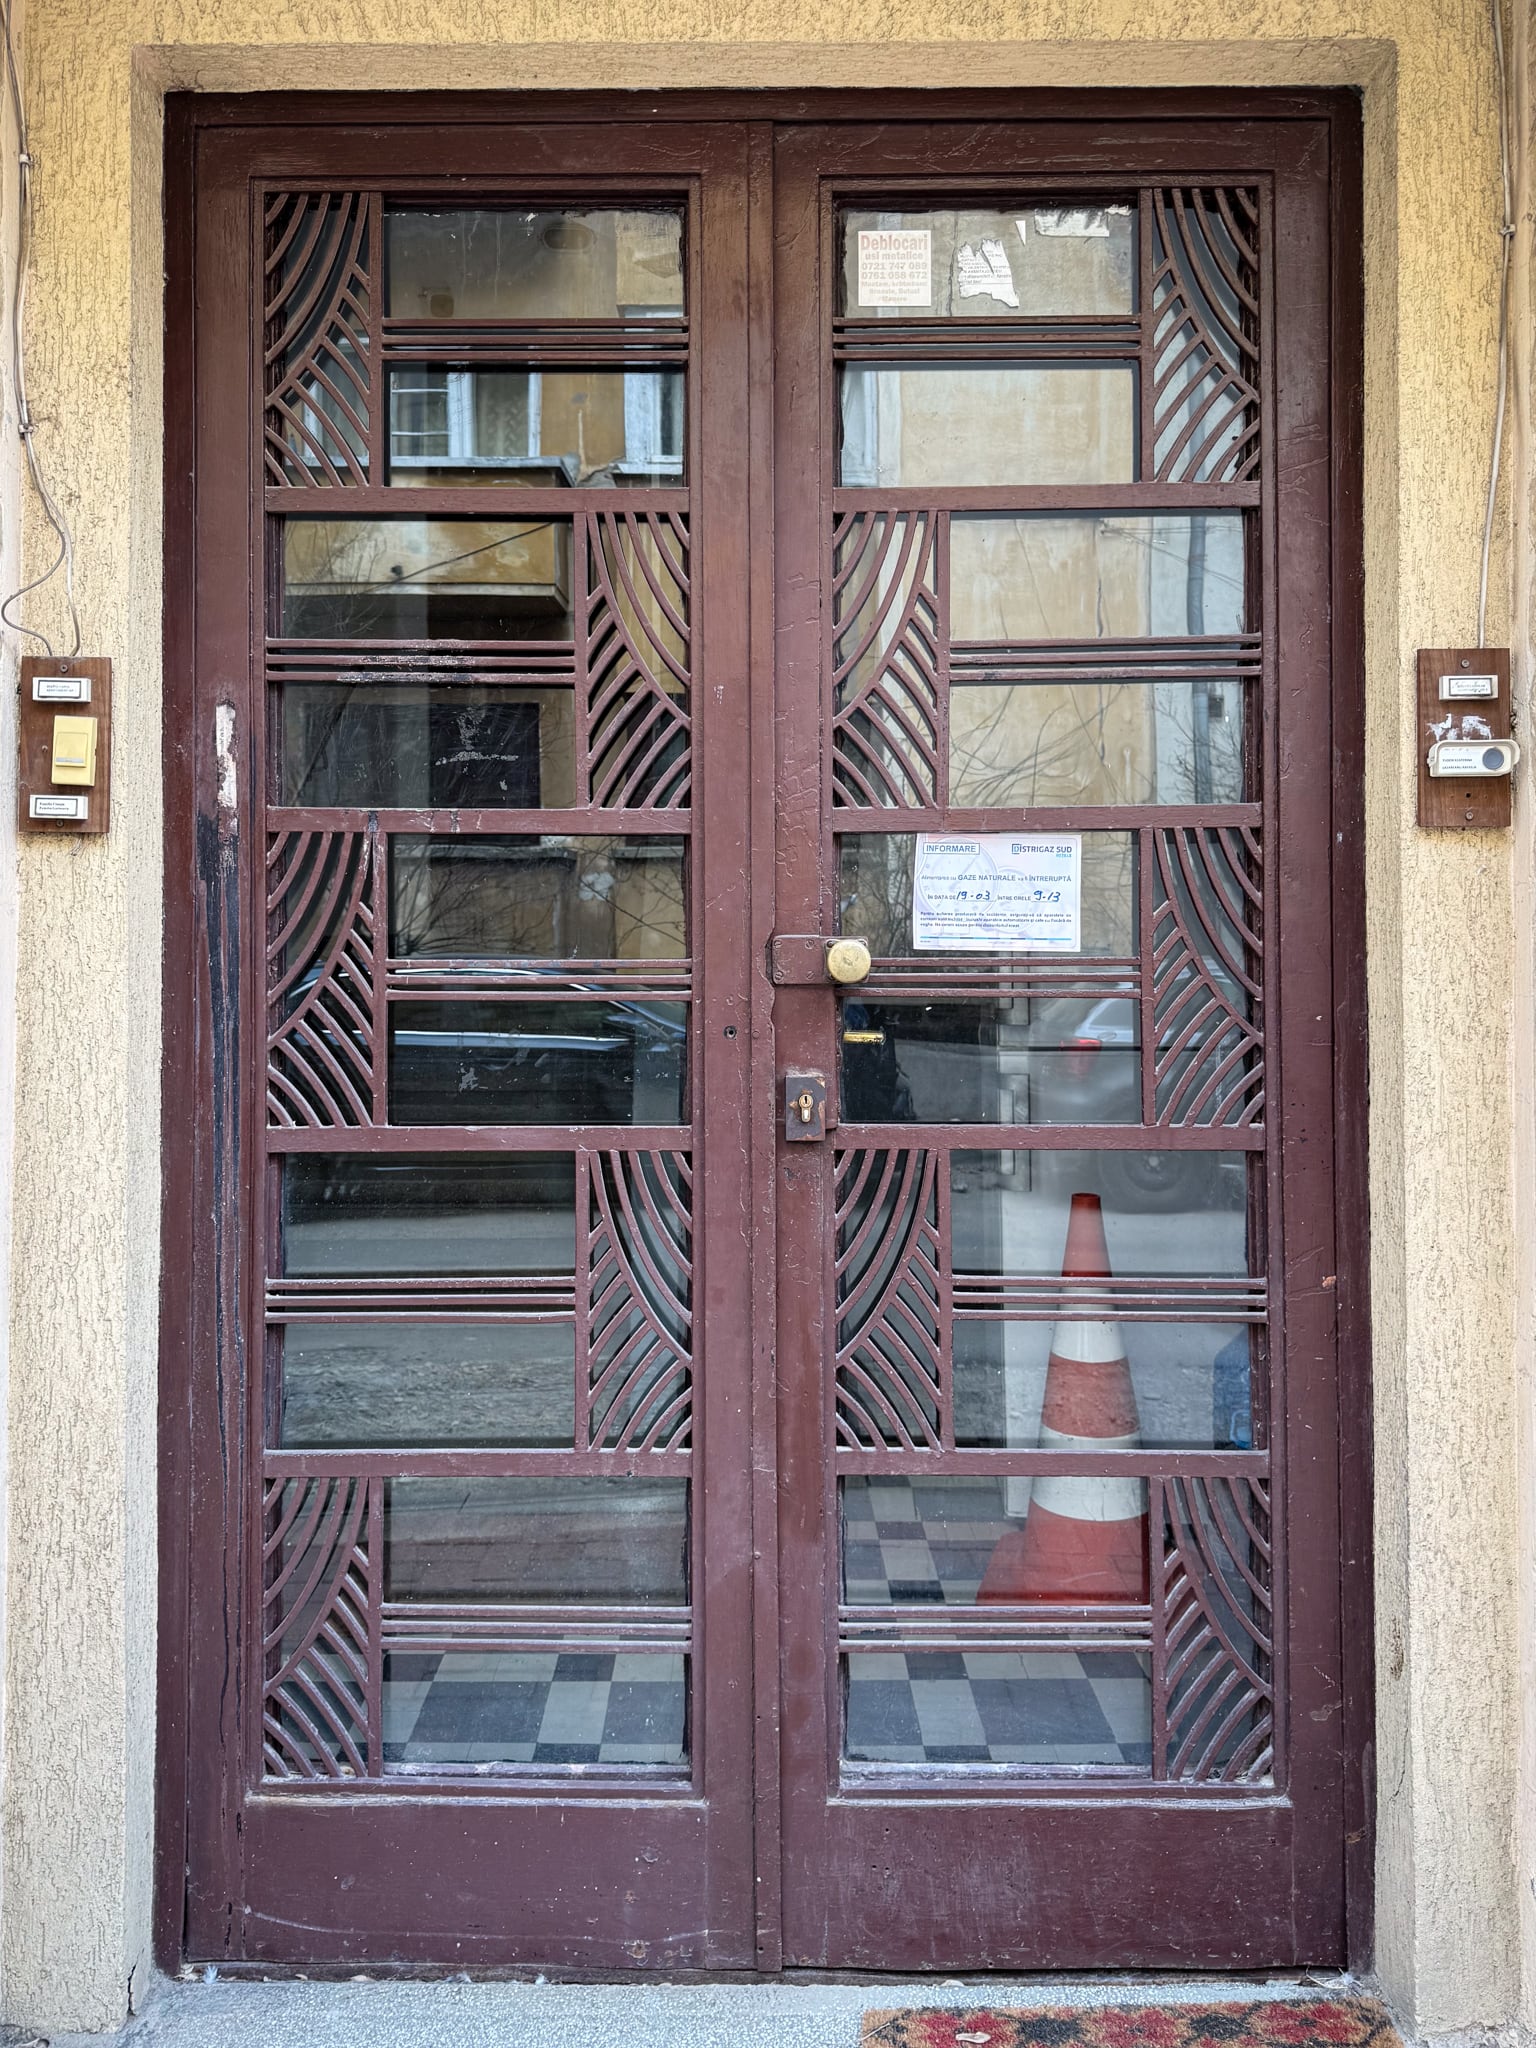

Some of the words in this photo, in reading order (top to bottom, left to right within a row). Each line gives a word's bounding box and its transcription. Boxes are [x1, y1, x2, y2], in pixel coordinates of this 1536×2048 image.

[861, 234, 928, 250] Deblocari
[865, 251, 880, 260] usi
[881, 251, 924, 260] metalice
[862, 262, 886, 270] 0721
[889, 262, 906, 270] 747
[926, 844, 976, 853] INFORMARE
[1012, 844, 1055, 854] DISTRIGAZ
[978, 874, 1016, 882] NATURALE
